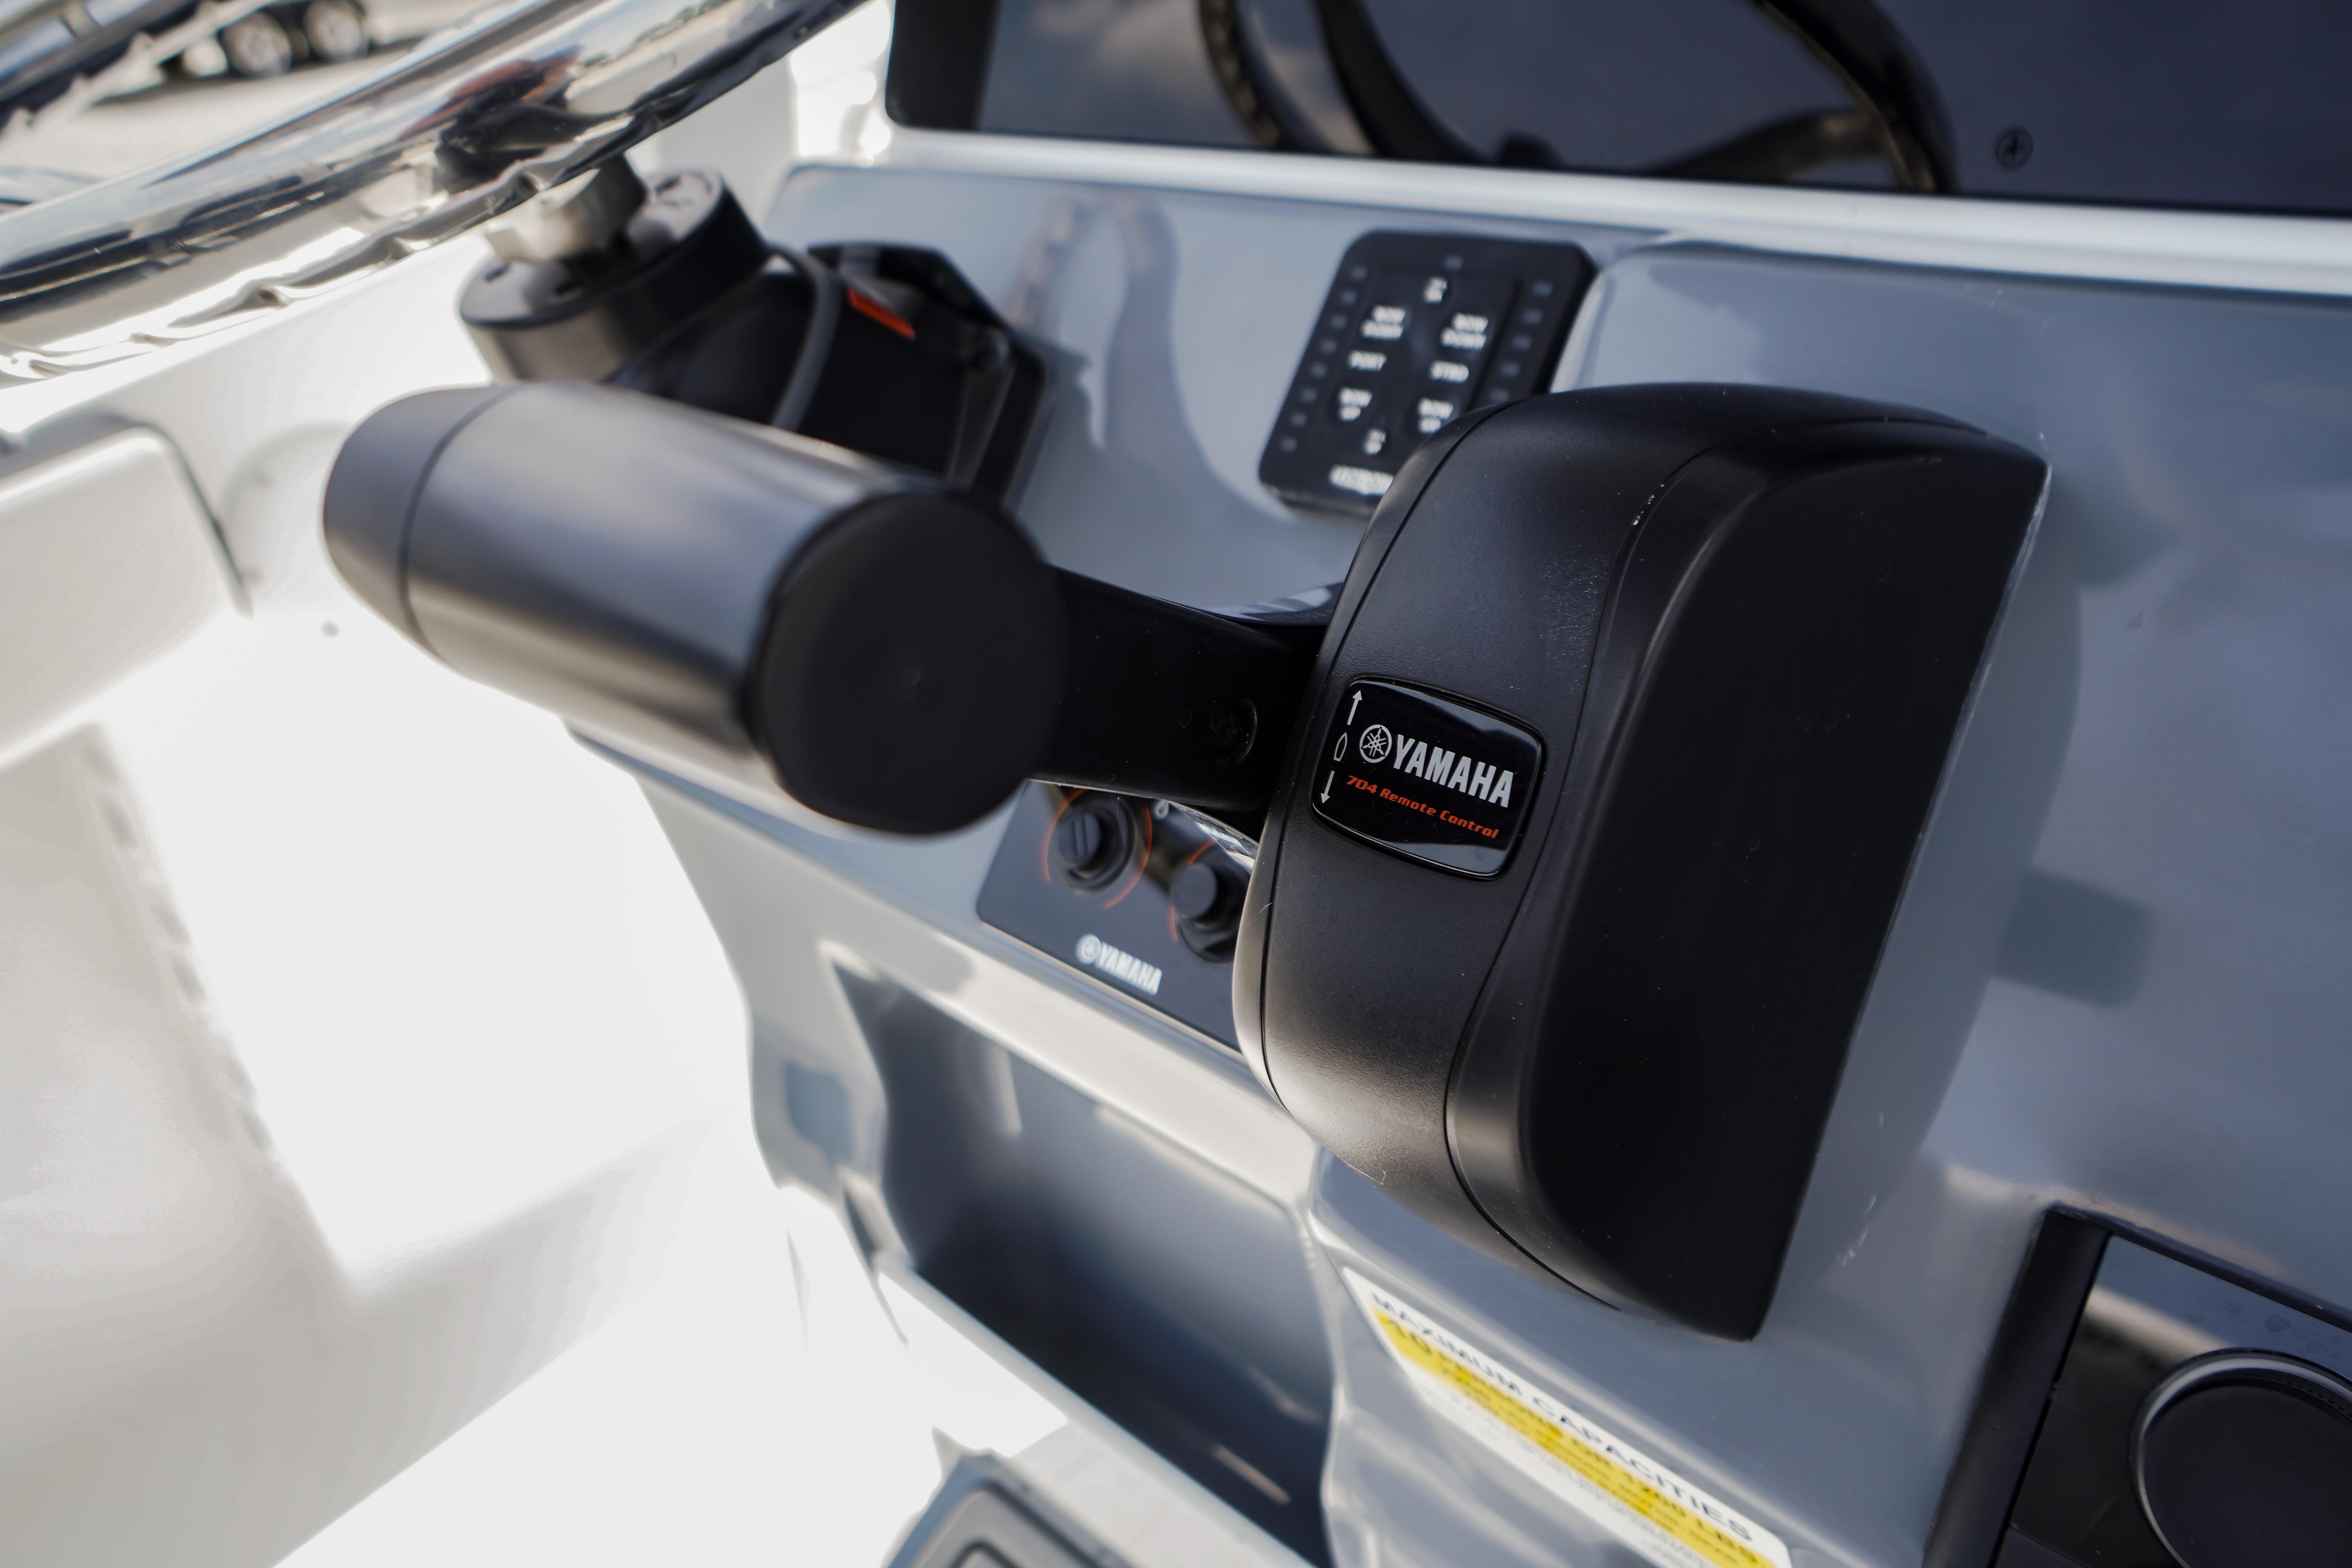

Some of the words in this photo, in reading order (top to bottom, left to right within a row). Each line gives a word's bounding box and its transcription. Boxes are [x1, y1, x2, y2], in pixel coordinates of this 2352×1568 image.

[1393, 734, 1514, 808] YAMAHA
[1346, 775, 1377, 794] 704
[1379, 788, 1437, 817] Remote
[1439, 810, 1500, 838] Control
[1095, 942, 1162, 995] YAMAHA
[1372, 1292, 1524, 1396] MAXIMUM
[1533, 1396, 1753, 1541] CAPACITIES
